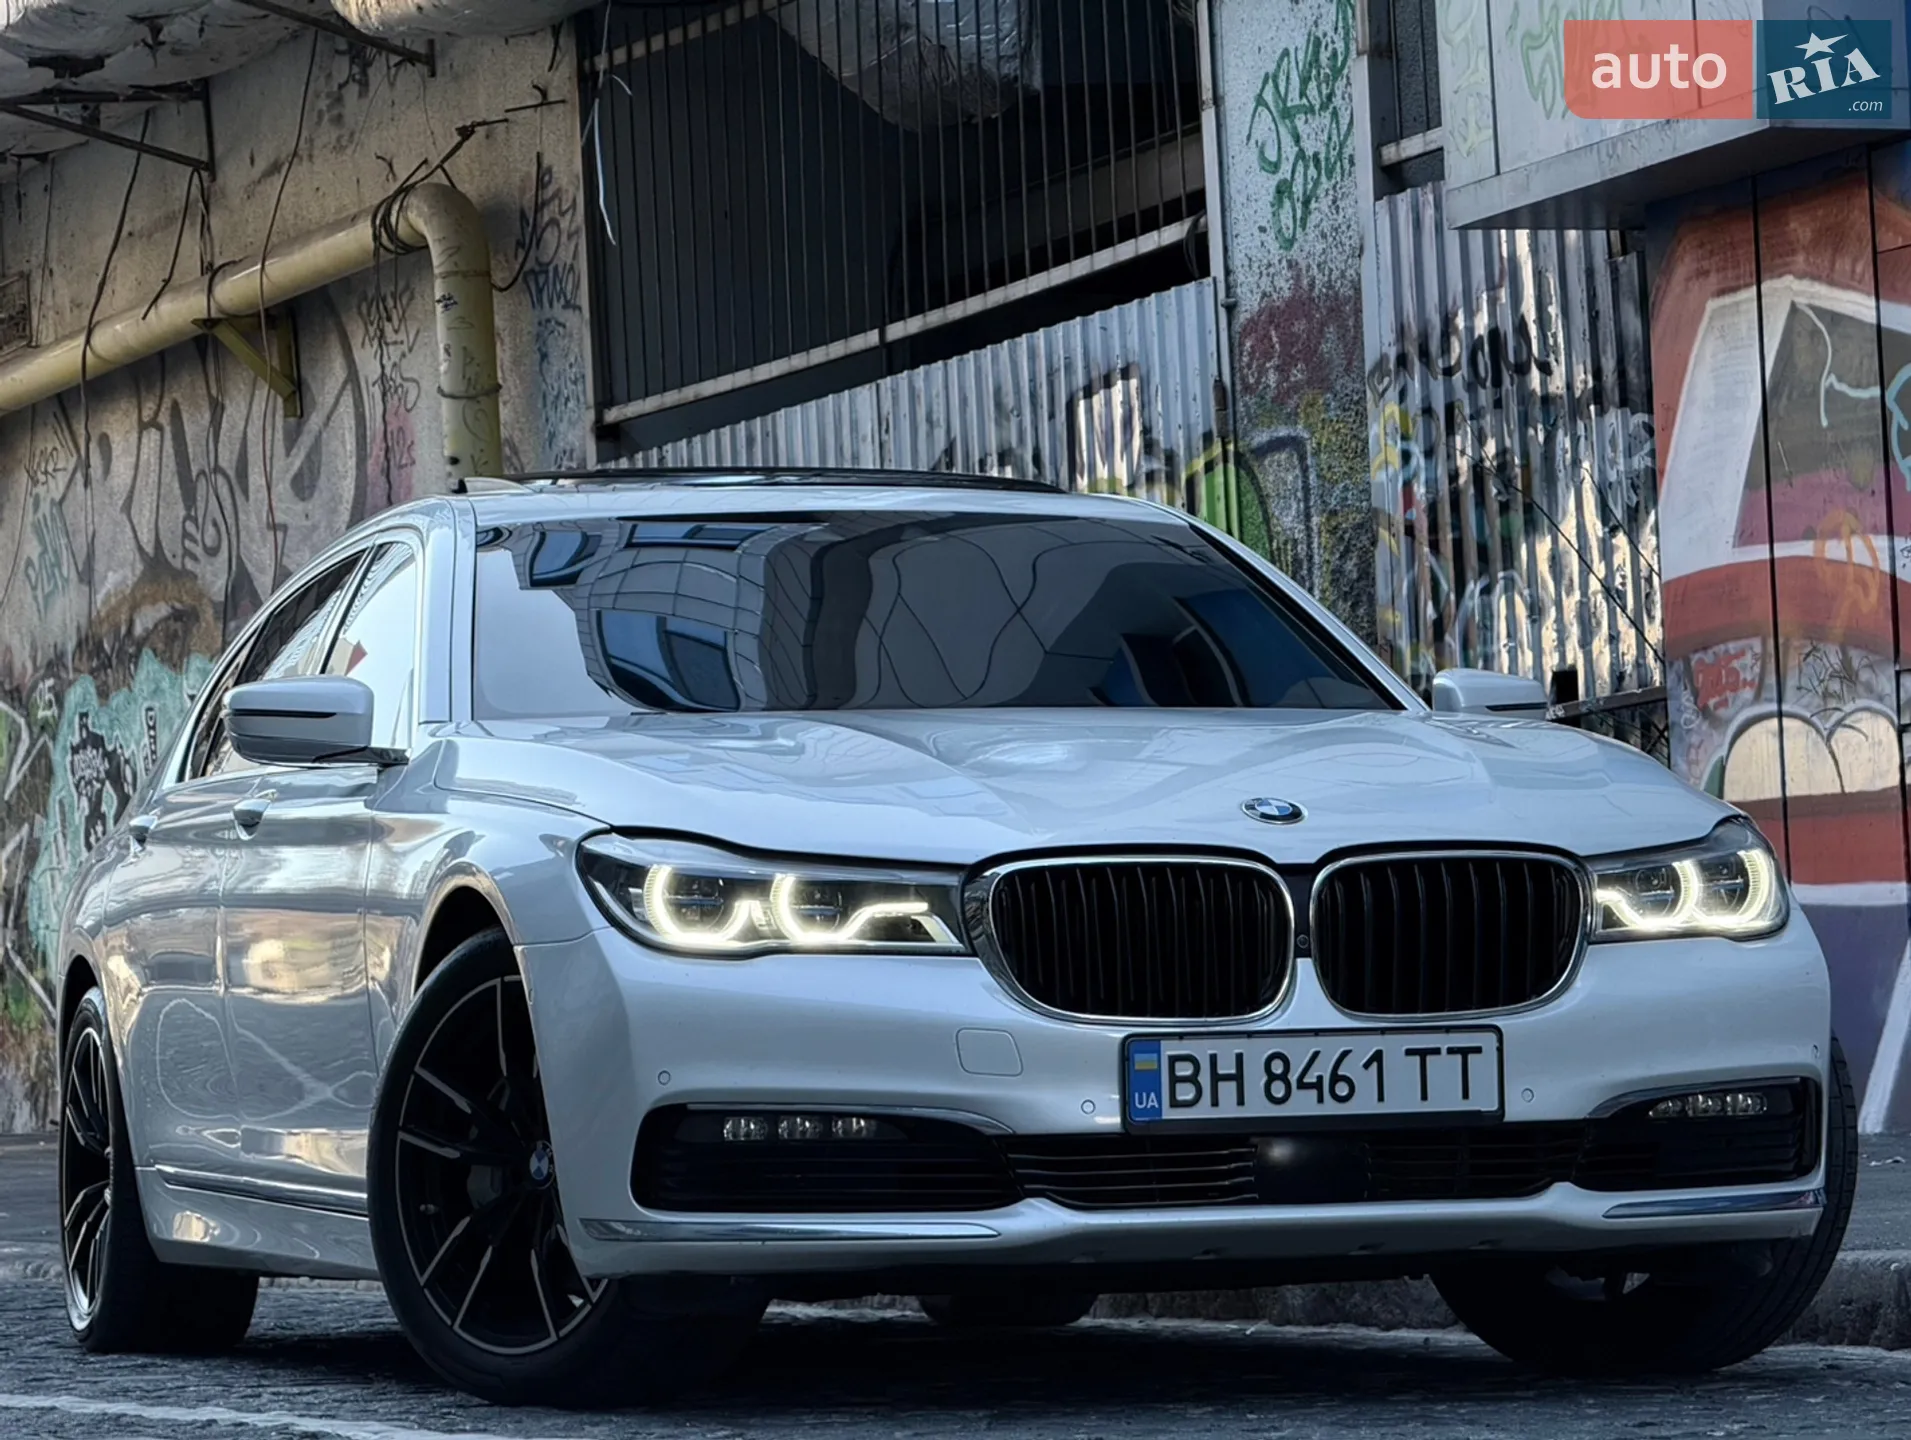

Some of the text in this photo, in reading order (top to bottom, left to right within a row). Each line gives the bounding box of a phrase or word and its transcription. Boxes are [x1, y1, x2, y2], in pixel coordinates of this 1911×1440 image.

[1167, 1045, 1483, 1108] BH 8461 TT
[1135, 1091, 1159, 1109] UA
